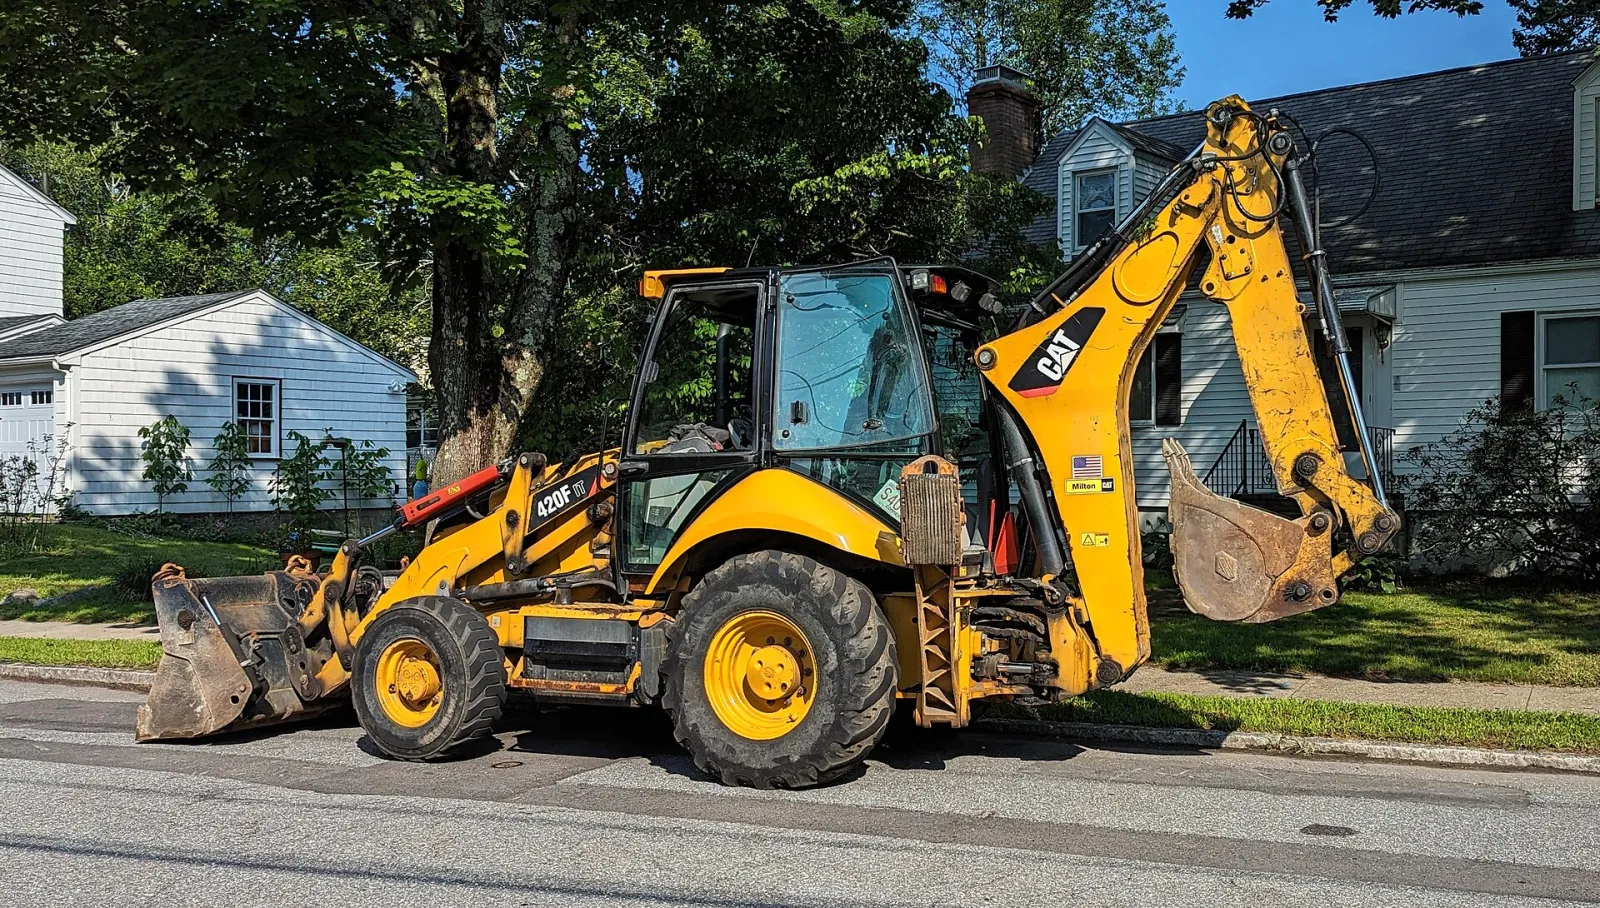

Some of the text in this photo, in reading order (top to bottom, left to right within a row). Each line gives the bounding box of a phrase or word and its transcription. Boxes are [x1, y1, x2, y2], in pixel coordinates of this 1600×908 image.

[1037, 328, 1080, 381] CAT
[537, 480, 586, 517] 420F IT
[1102, 481, 1112, 489] CAT
